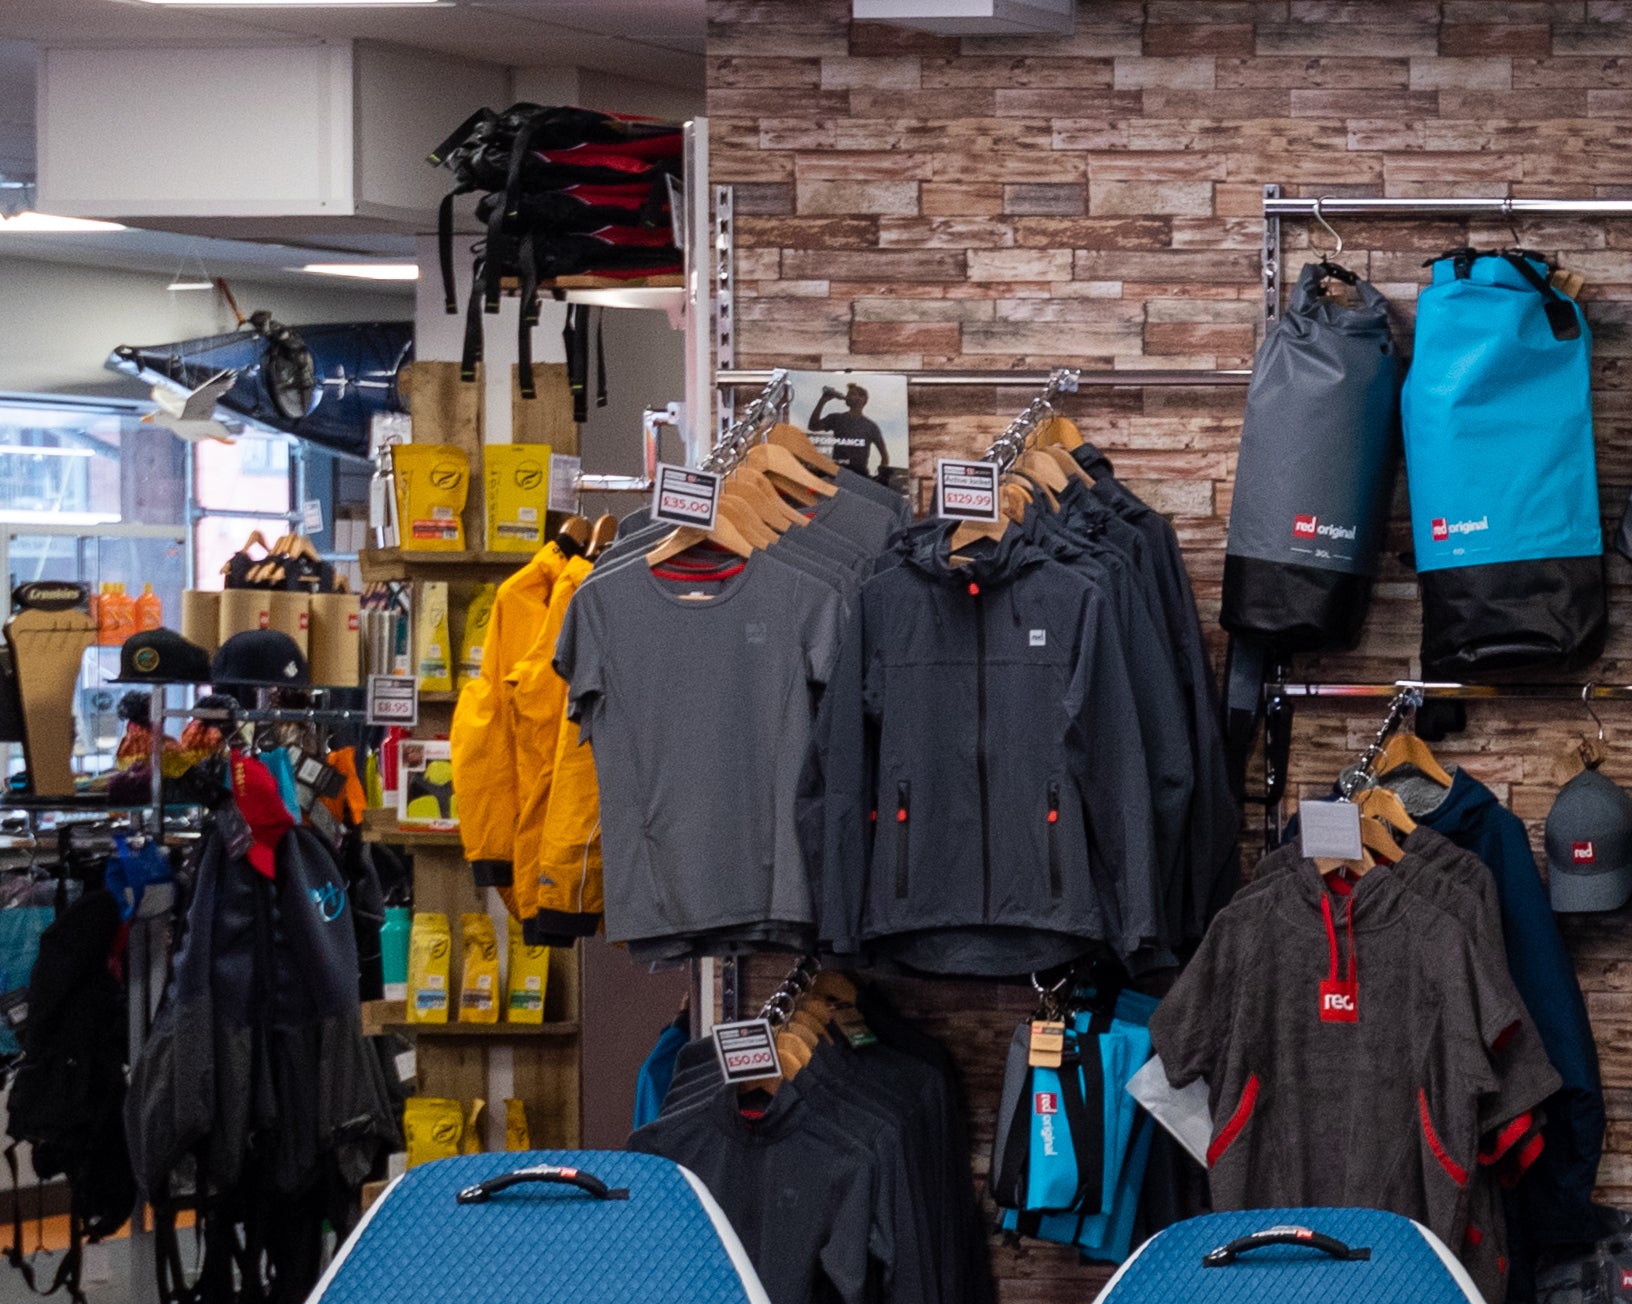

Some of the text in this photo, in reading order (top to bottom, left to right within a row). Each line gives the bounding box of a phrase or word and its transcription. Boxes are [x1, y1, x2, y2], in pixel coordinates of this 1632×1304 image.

[663, 495, 710, 514] £35.00
[946, 492, 991, 506] £129.99
[1294, 516, 1357, 541] red original
[1433, 515, 1489, 535] red original
[1574, 841, 1593, 858] red
[1324, 991, 1355, 1011] red
[727, 1053, 773, 1069] £50.00
